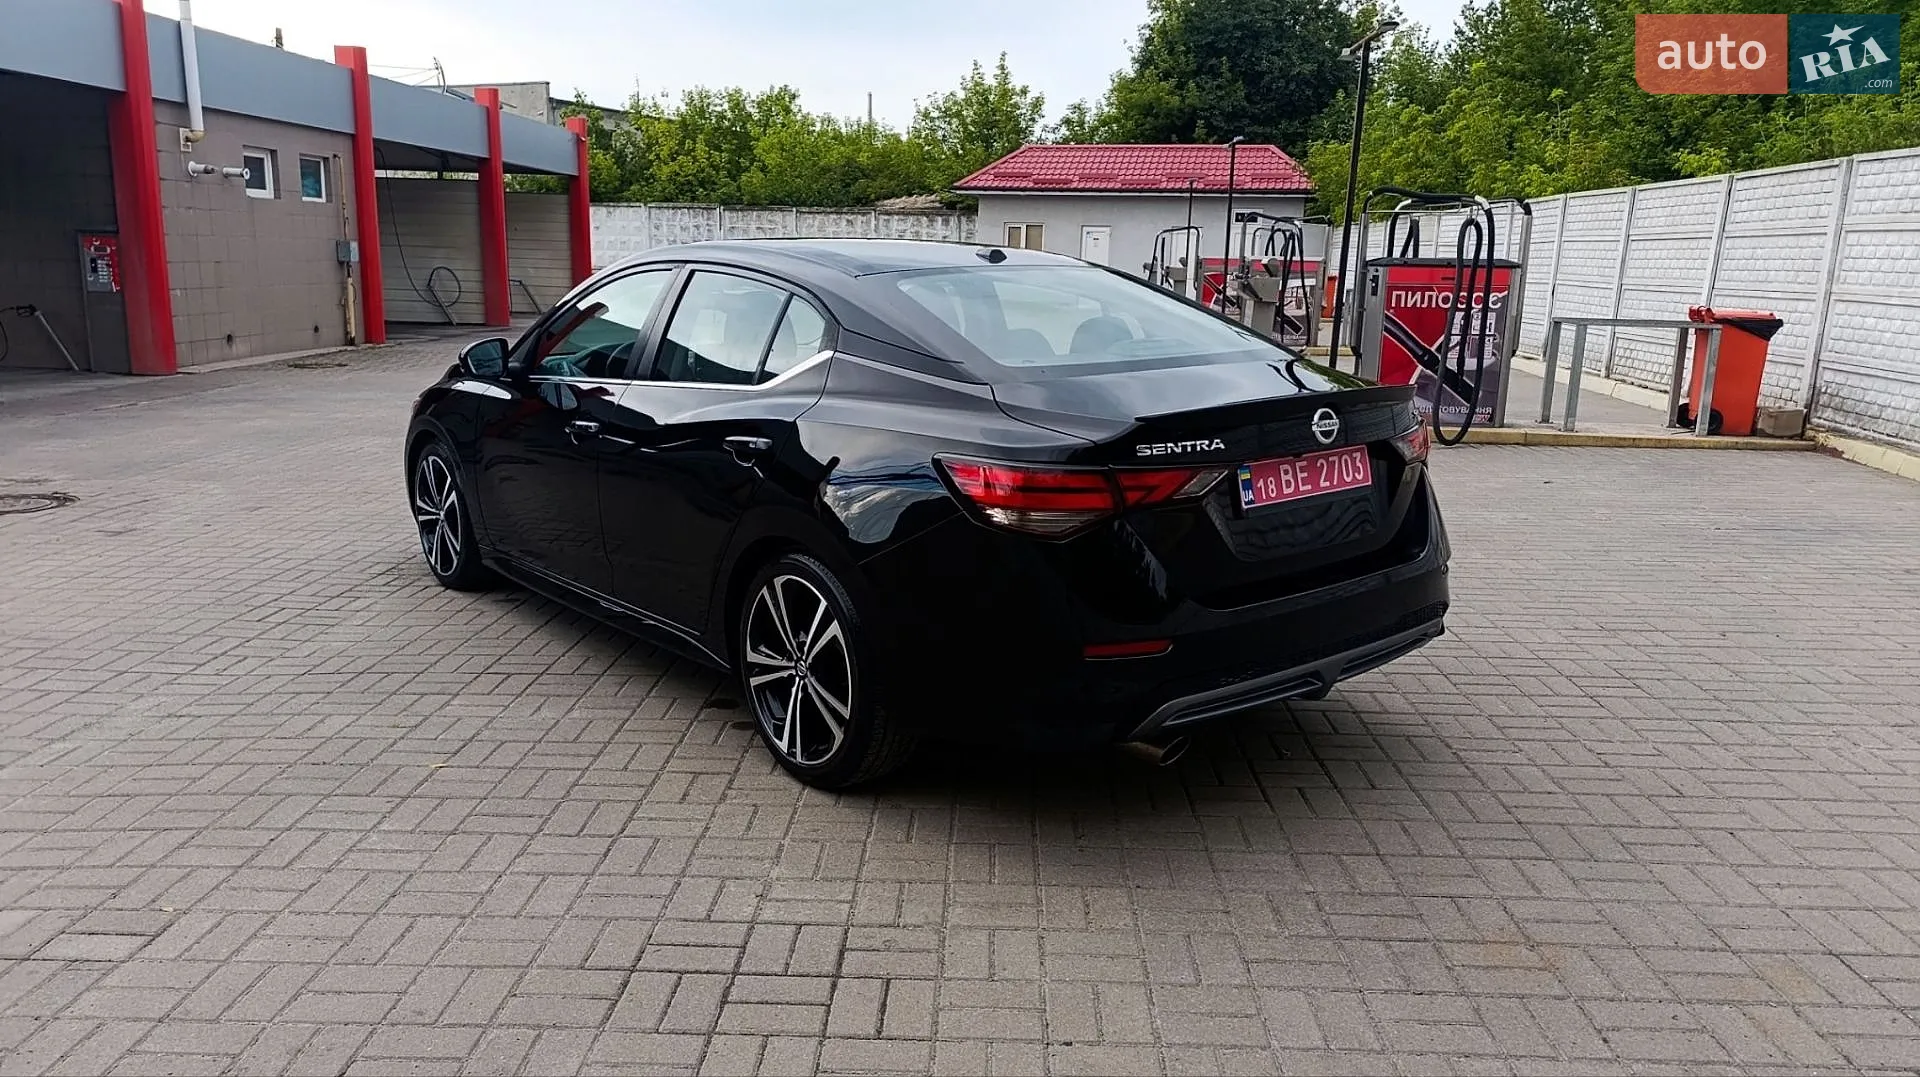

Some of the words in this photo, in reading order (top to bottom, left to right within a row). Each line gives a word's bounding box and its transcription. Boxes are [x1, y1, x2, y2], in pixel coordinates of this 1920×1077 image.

[1136, 439, 1226, 457] SENTRA
[1257, 479, 1277, 500] 18
[1279, 461, 1312, 496] BE
[1316, 452, 1365, 488] 2703
[1243, 489, 1255, 503] UA
